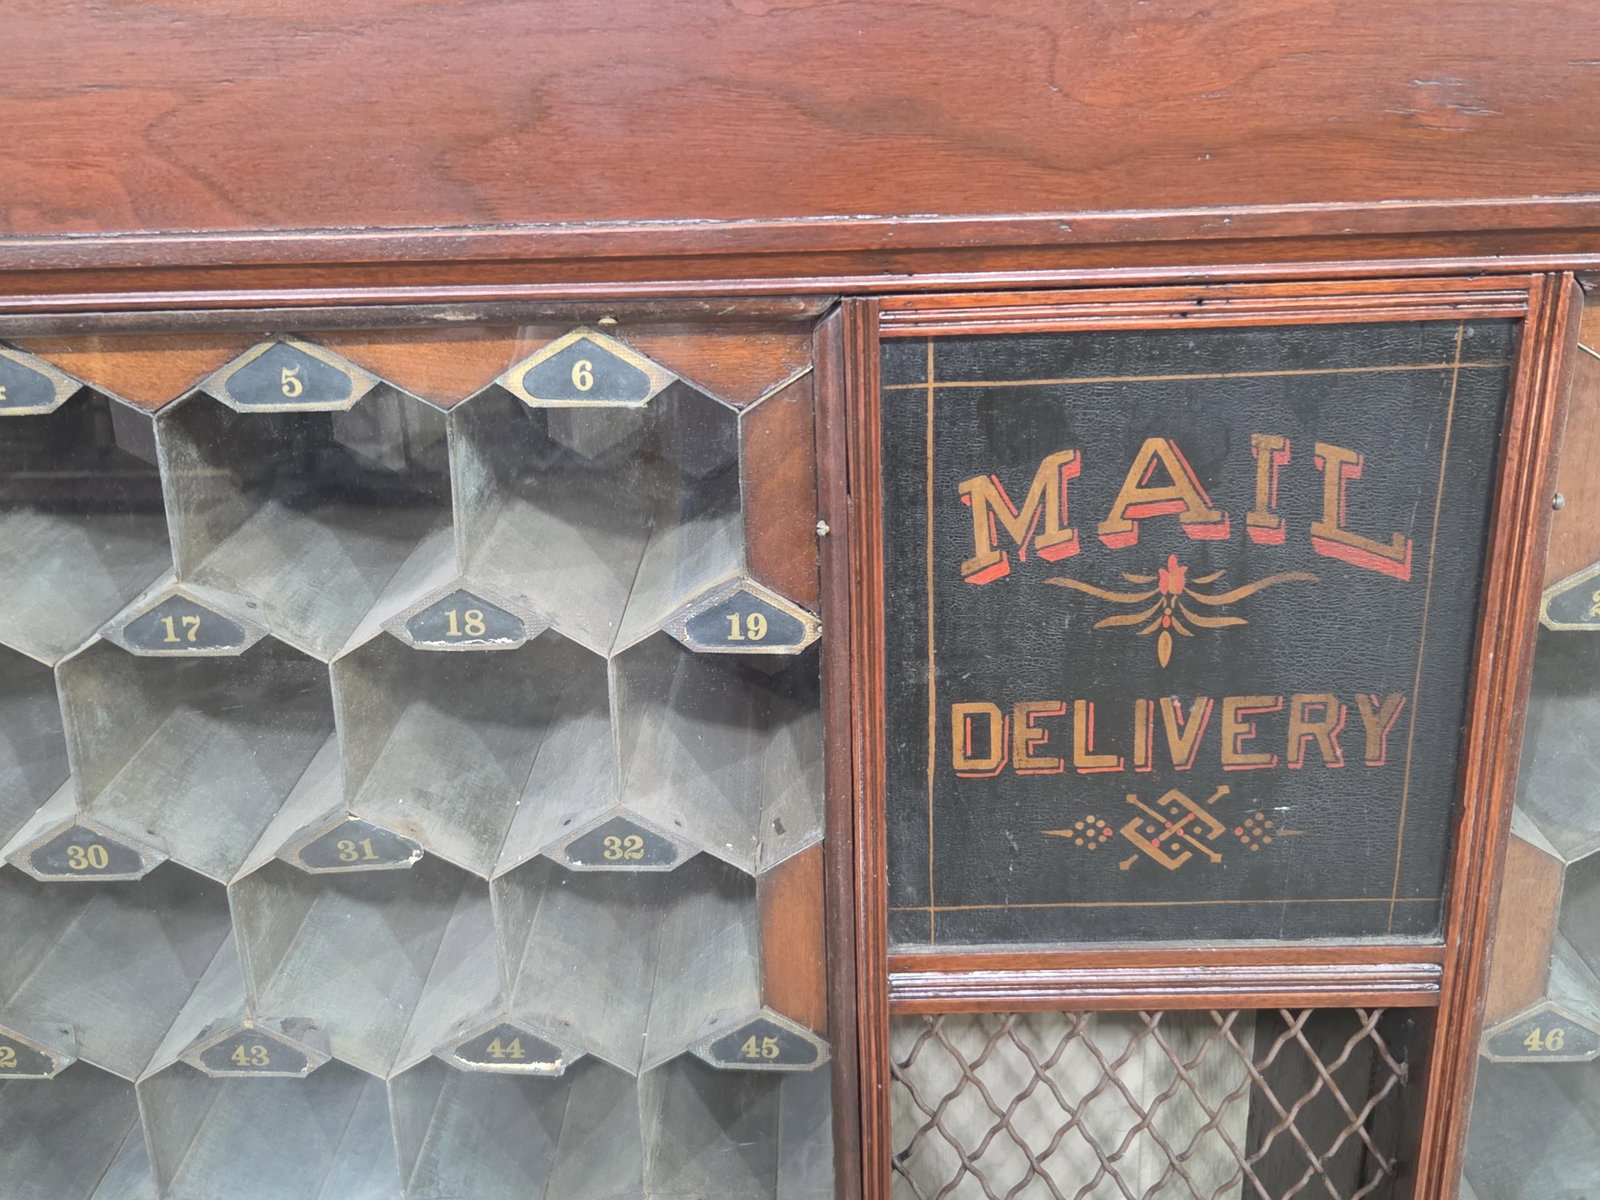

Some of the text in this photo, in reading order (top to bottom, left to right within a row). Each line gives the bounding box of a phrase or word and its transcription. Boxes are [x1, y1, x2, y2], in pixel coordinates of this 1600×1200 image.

[281, 366, 303, 398] 5
[571, 360, 594, 391] 6
[958, 433, 1413, 585] MAIL
[160, 615, 201, 642] 17
[444, 608, 487, 637] 18
[726, 612, 768, 641] 19
[951, 693, 1406, 778] DELIVERY
[66, 843, 109, 870] 30
[336, 838, 379, 863] 31
[603, 834, 645, 861] 32
[486, 1036, 525, 1059] 44
[740, 1034, 780, 1060] 45
[1523, 1027, 1565, 1052] 46
[230, 1044, 270, 1067] 43
